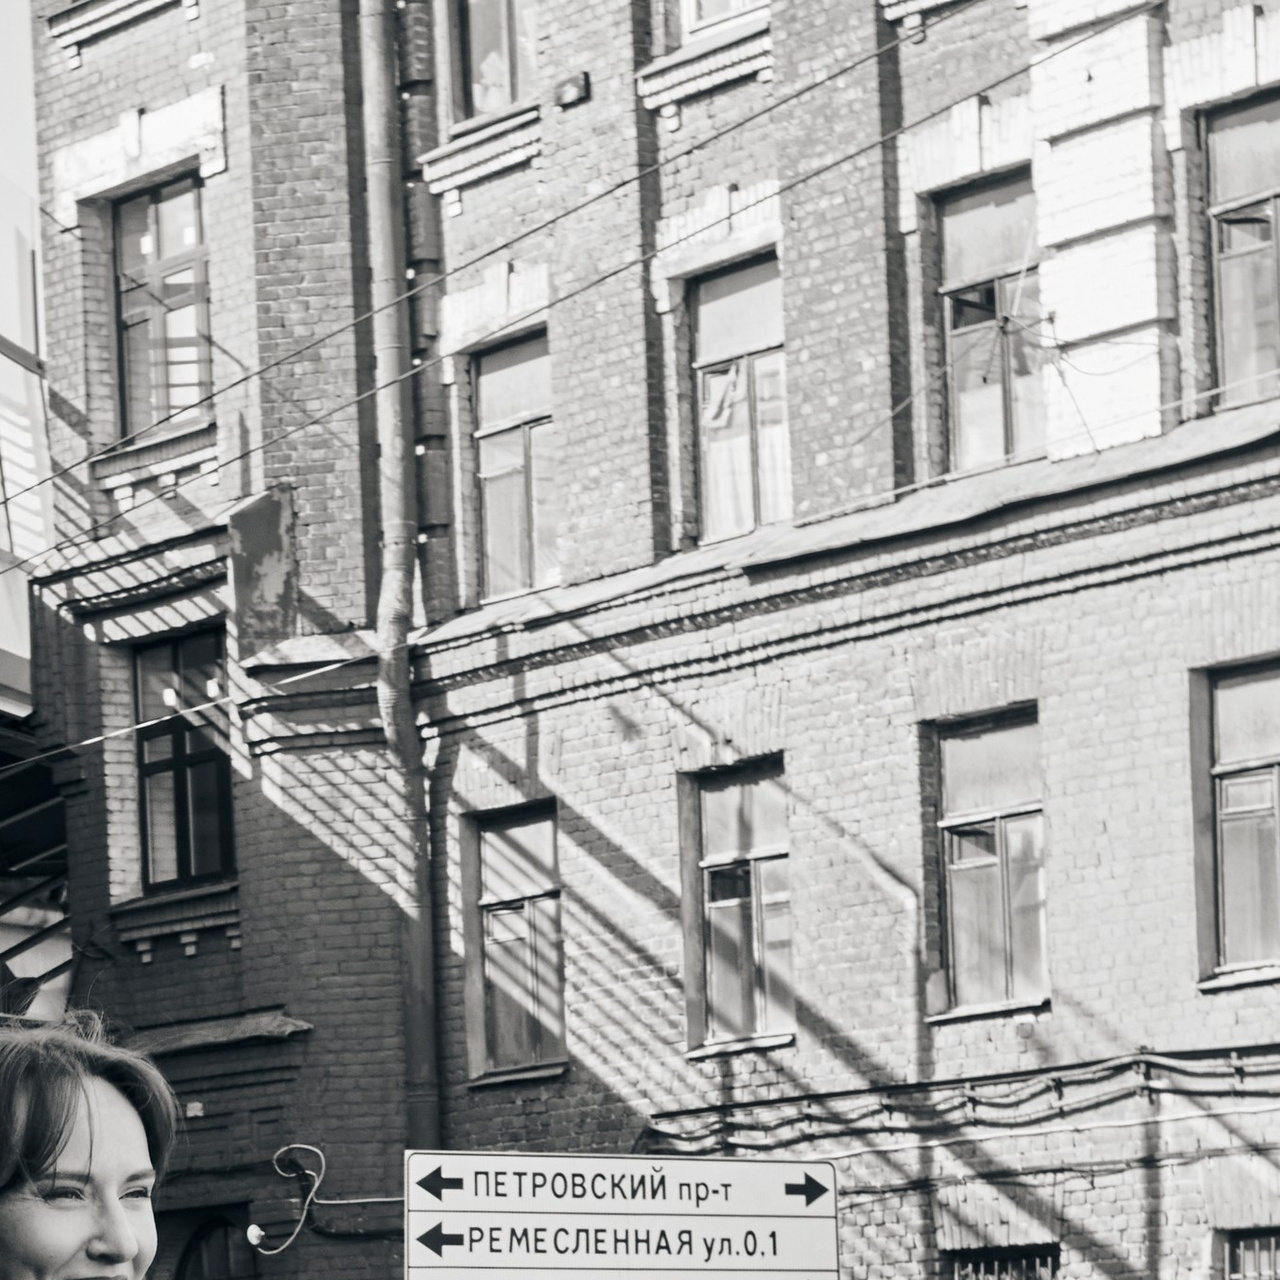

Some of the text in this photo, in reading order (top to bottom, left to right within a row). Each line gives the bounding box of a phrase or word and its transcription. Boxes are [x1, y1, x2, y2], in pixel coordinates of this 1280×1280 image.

[474, 1166, 732, 1208] ПЕТРОВСКИЙ пр-т
[469, 1226, 693, 1255] РЕМЕСЛЕННАЯ
